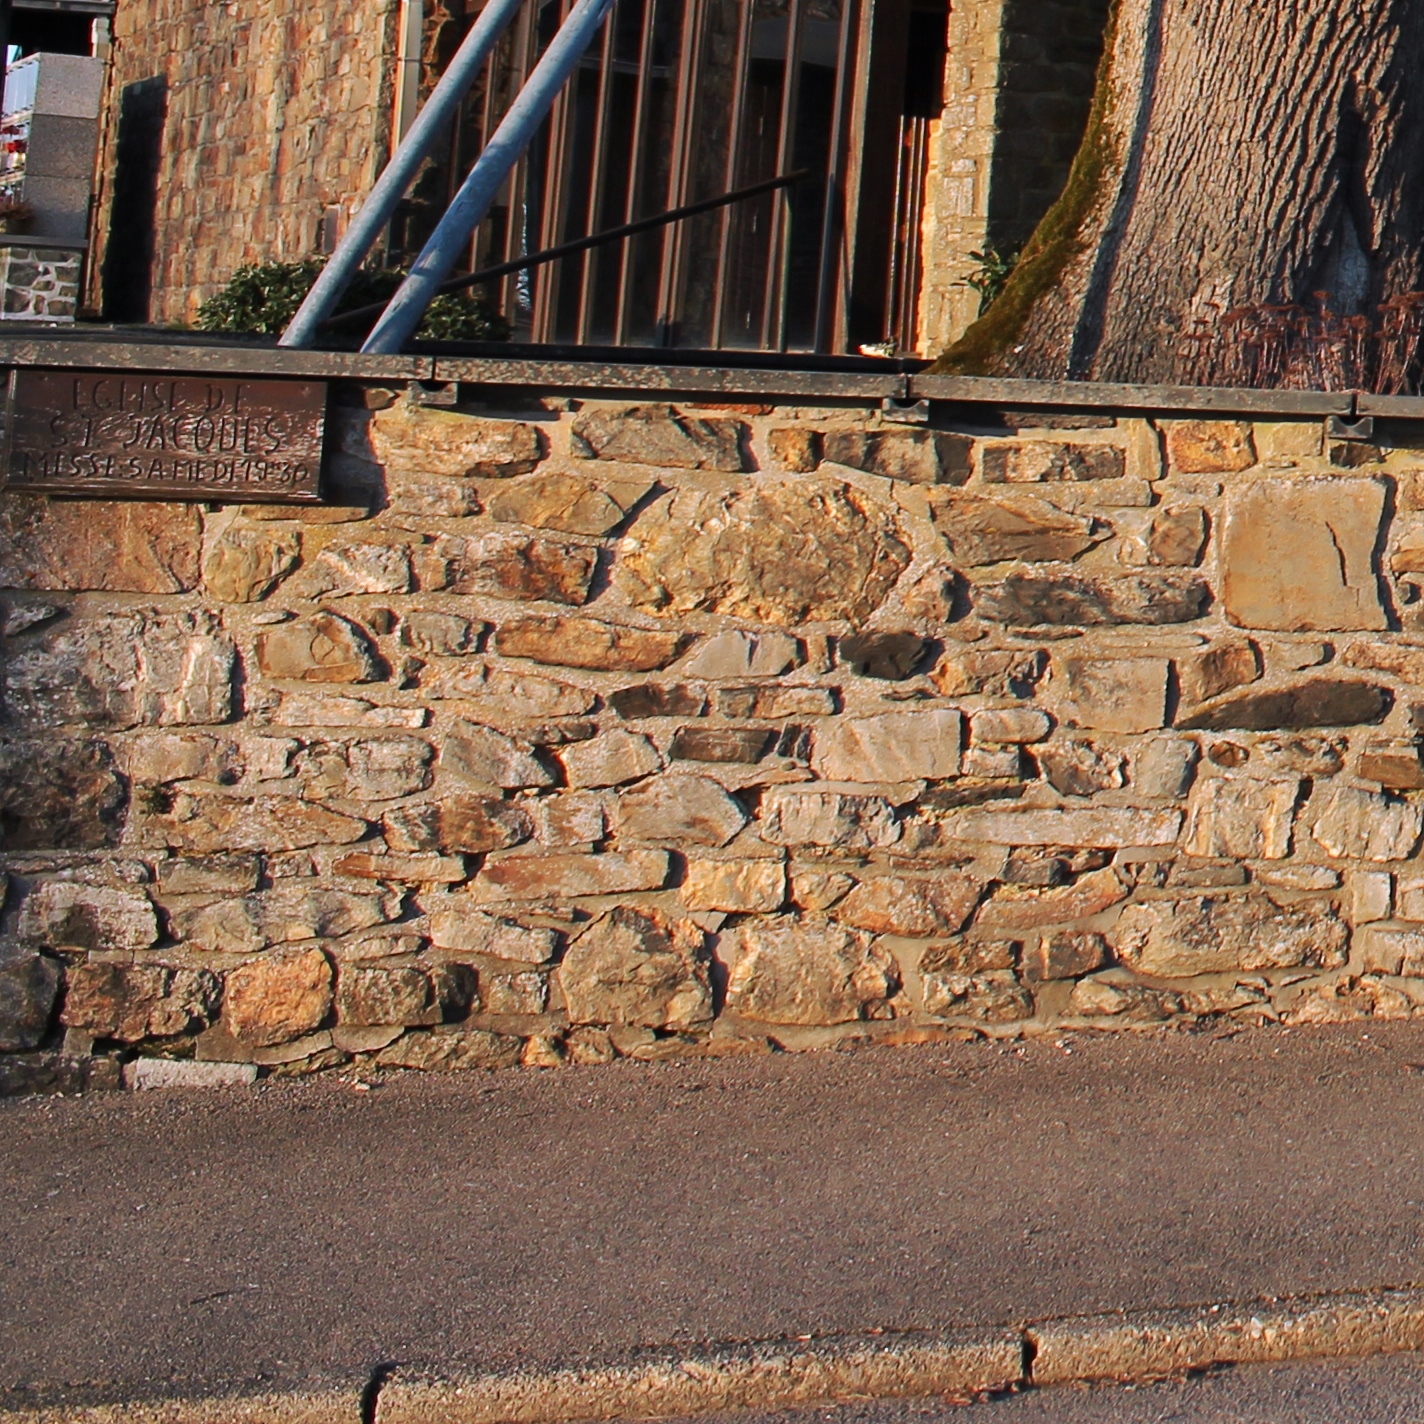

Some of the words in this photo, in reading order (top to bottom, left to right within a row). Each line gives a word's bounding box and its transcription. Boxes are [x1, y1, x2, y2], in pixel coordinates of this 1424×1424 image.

[72, 377, 184, 412] EGLISE
[205, 383, 249, 414] DE
[123, 415, 282, 455] JACQUES
[129, 457, 235, 483] SAMEDI
